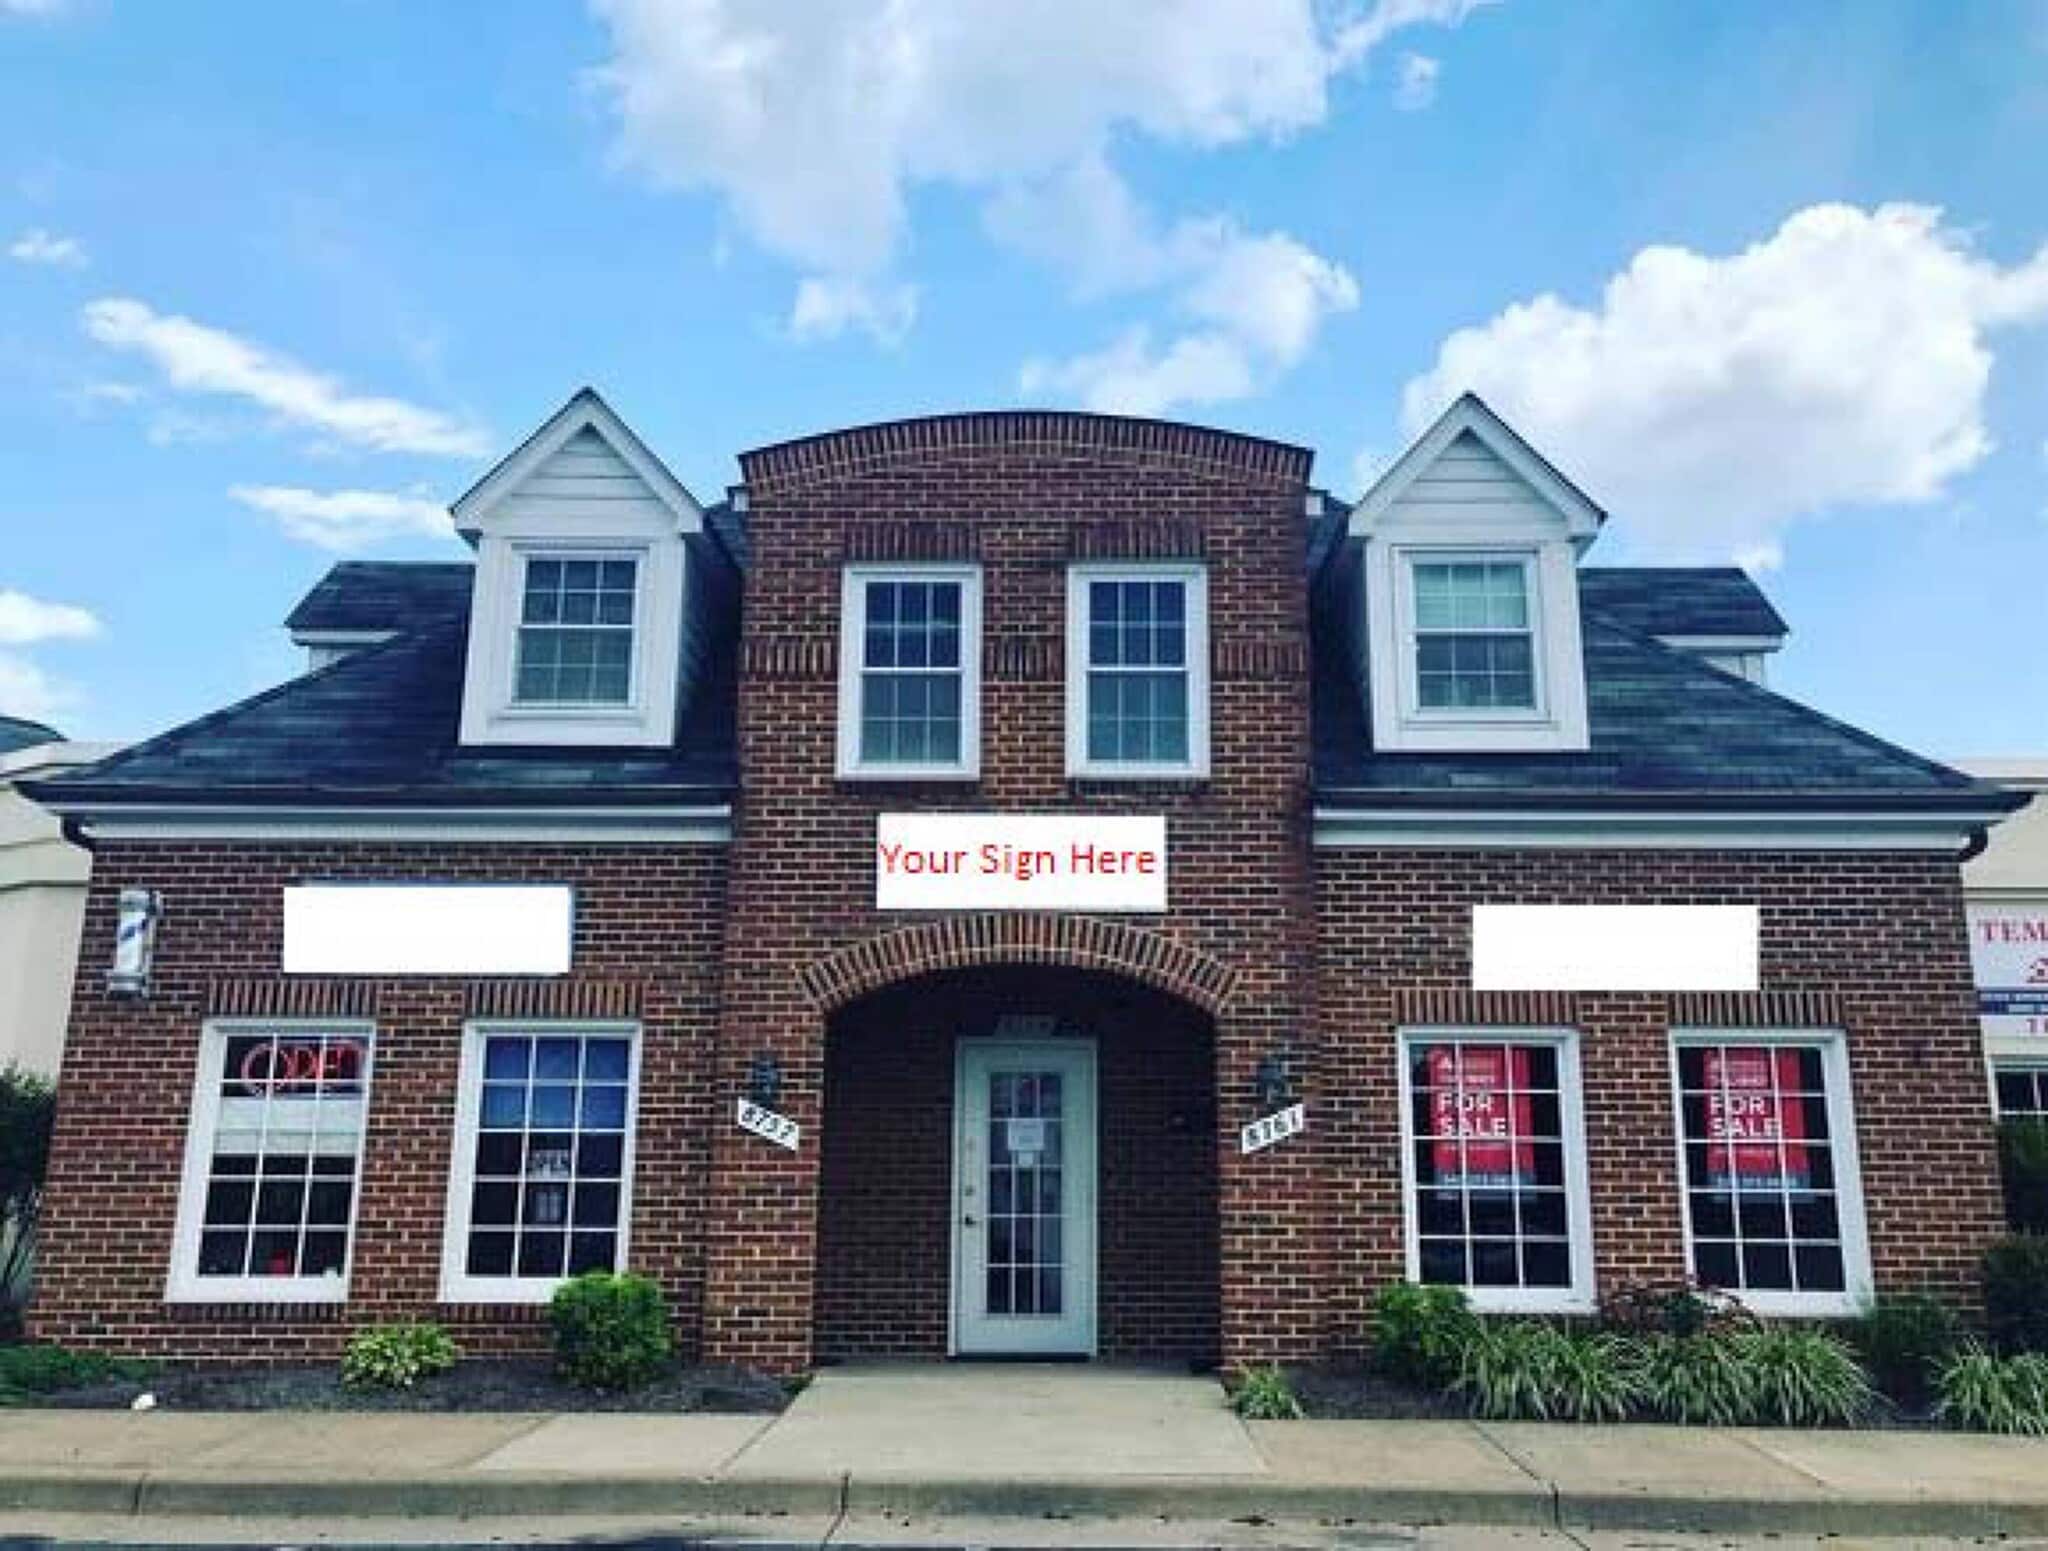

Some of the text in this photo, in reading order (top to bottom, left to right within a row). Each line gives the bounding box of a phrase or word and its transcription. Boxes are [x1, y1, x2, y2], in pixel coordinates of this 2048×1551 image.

[1438, 1092, 1493, 1113] FOR
[1709, 1095, 1766, 1116] FOR
[1438, 1117, 1507, 1137] SALE
[1710, 1117, 1782, 1137] SALE
